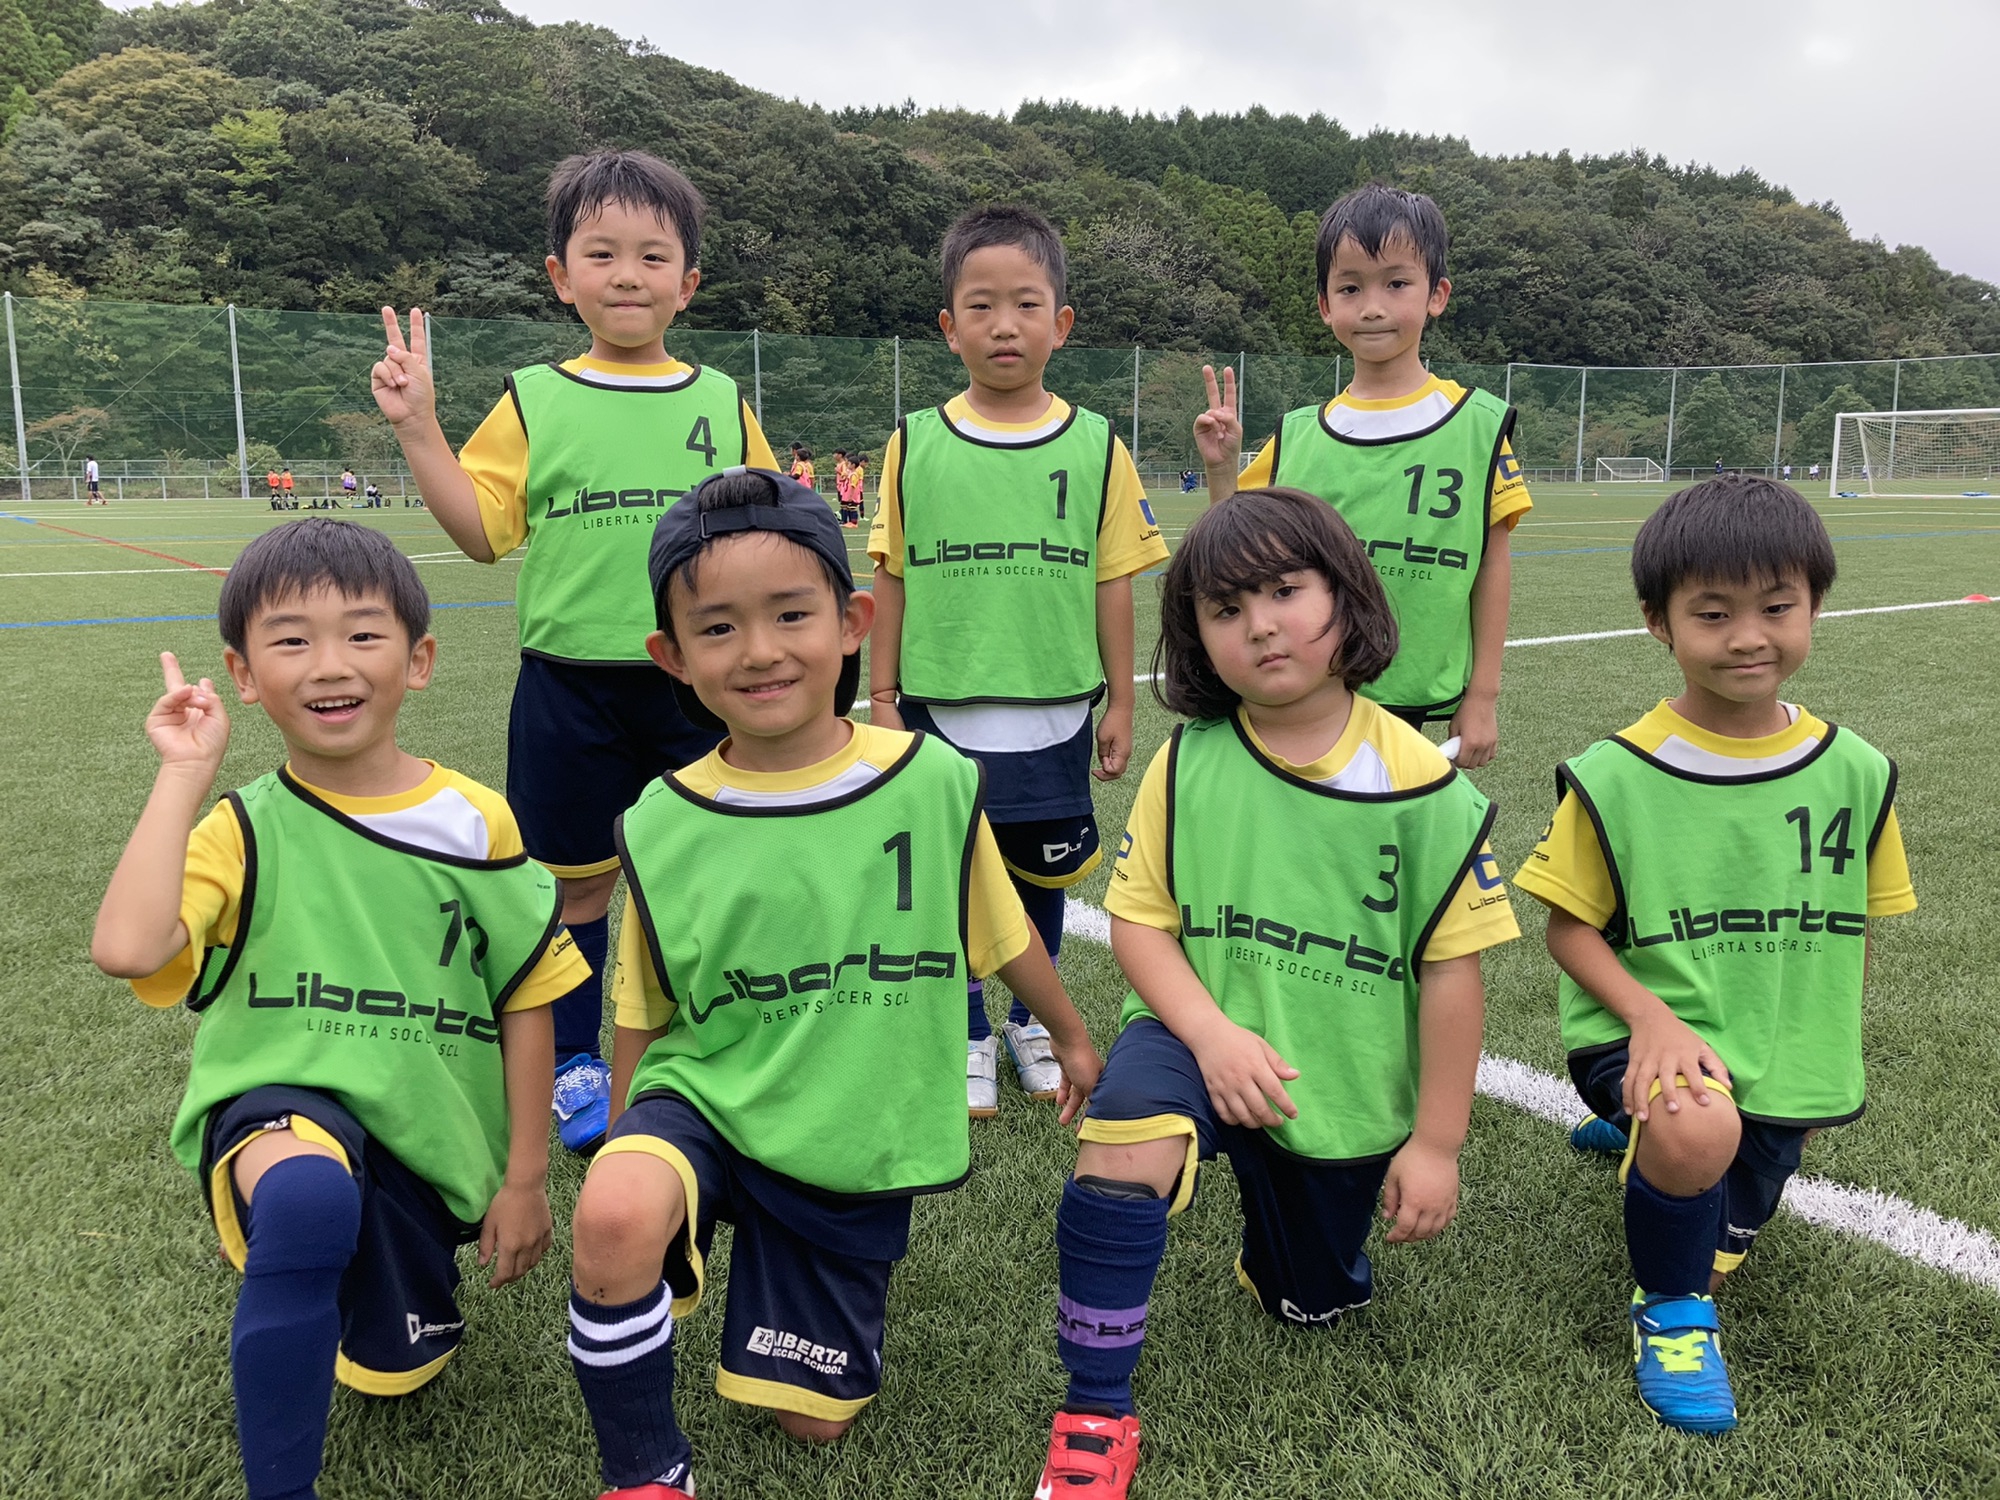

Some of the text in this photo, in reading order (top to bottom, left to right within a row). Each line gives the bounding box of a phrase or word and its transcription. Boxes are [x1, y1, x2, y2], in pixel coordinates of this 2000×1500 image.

[686, 415, 717, 467] 4
[544, 485, 698, 520] Liber
[1048, 469, 1068, 520] 1
[1403, 464, 1464, 519] 13
[583, 514, 639, 530] LIBERTA
[908, 537, 1090, 568] Liberta
[942, 565, 1068, 580] LIBERTA SOCCER SCL
[1410, 570, 1433, 581] SCL
[1784, 806, 1855, 875] 14
[882, 831, 913, 911] 1
[1361, 844, 1400, 913] 3
[688, 943, 957, 1025] Liberta
[1276, 959, 1344, 988] SOCCER
[1351, 979, 1377, 997] SCL
[883, 991, 910, 1007] SCL
[307, 1018, 378, 1038] LIBERTA
[438, 1043, 460, 1058] SCL
[803, 1356, 844, 1376] SCHOOL
